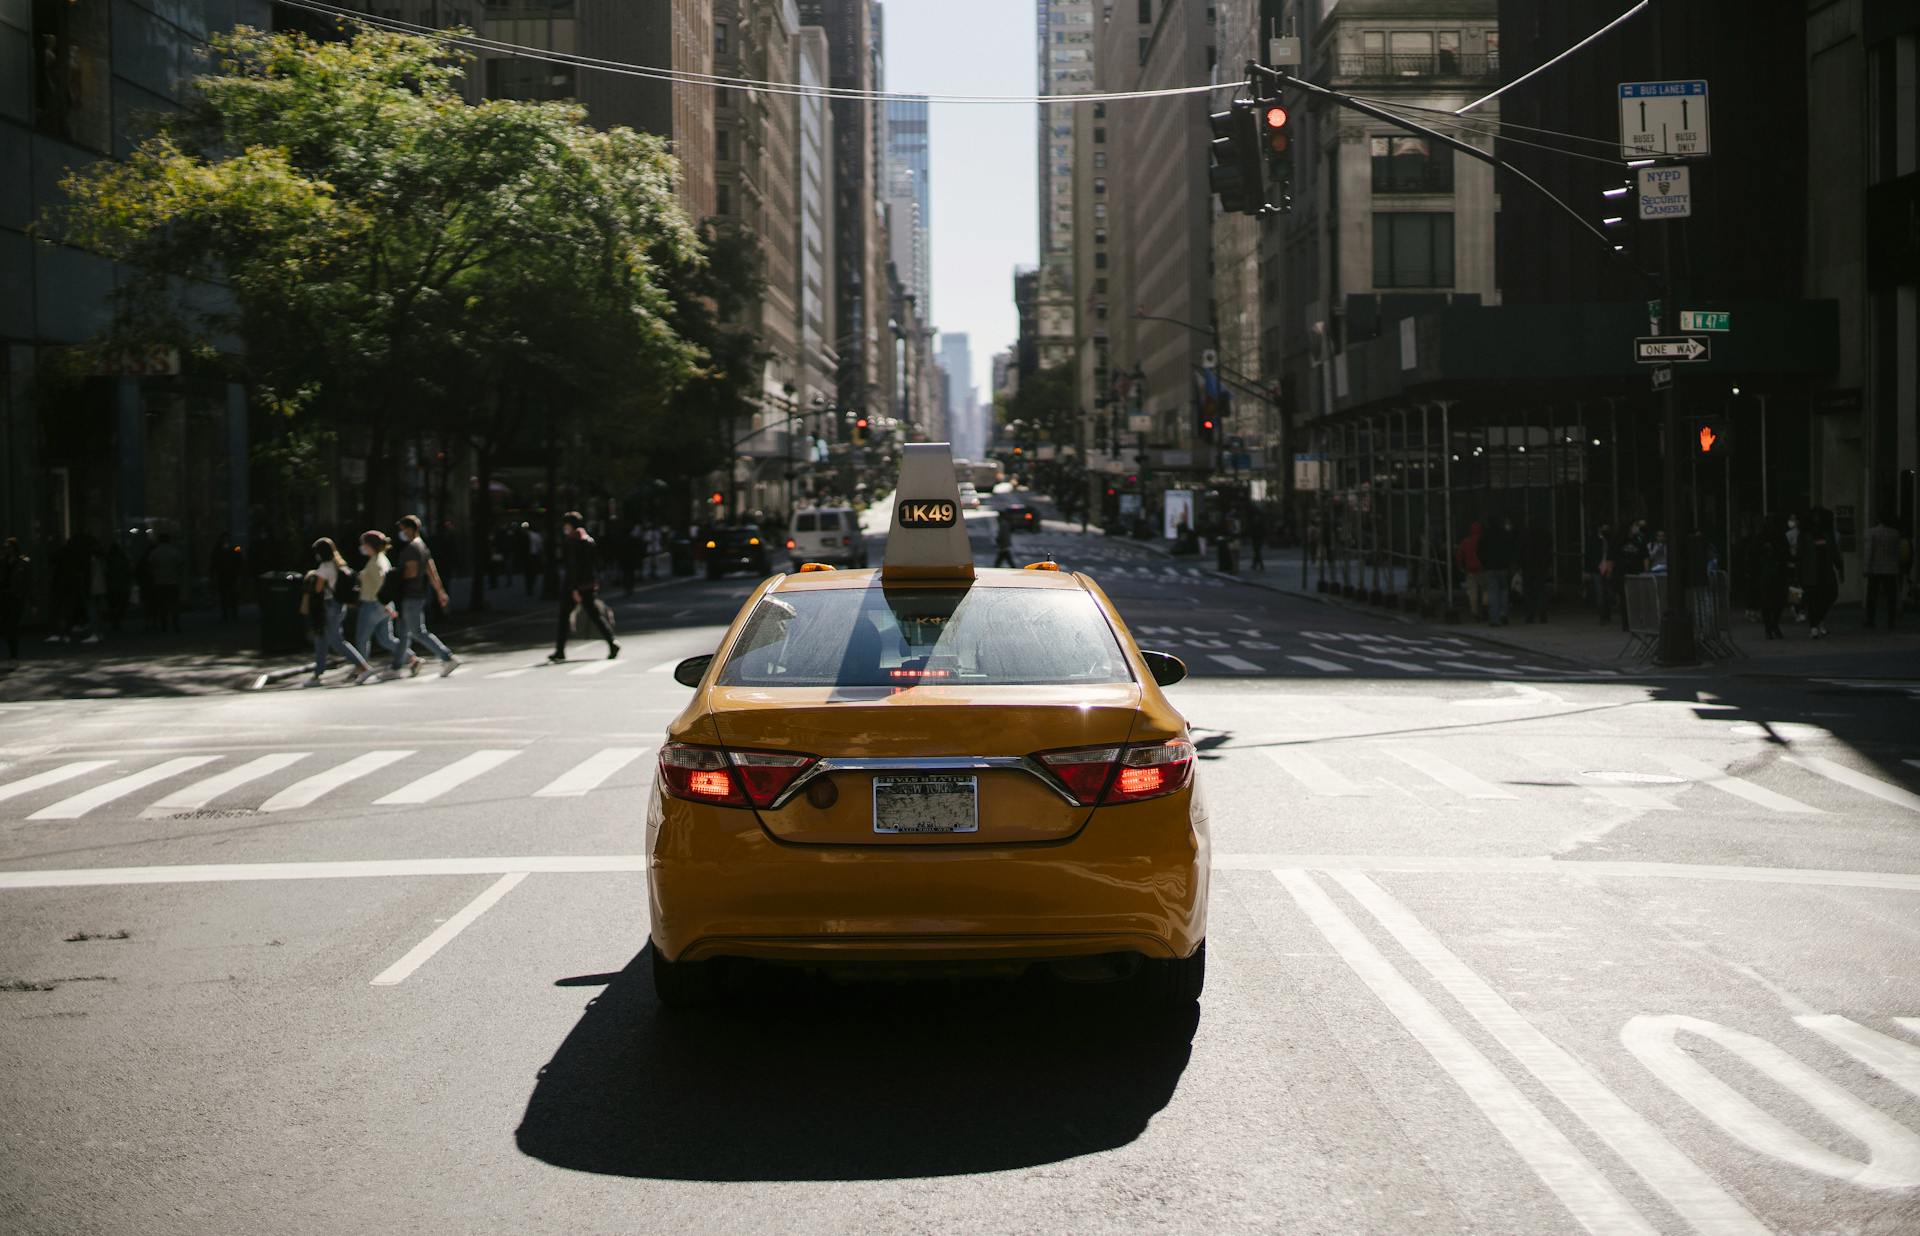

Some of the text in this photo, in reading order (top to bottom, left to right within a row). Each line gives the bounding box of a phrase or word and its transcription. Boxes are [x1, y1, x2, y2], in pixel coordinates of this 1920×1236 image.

[1640, 84, 1686, 95] BUS LANES
[1633, 134, 1655, 144] BUSES
[1675, 132, 1697, 142] BUSES
[1635, 145, 1654, 154] ONLY
[1677, 143, 1696, 152] ONLY
[1647, 170, 1681, 182] NYPD
[1696, 314, 1703, 329] W
[1706, 314, 1718, 329] 47
[1719, 315, 1728, 323] ST
[1646, 344, 1699, 355] ONE WAY
[902, 503, 954, 522] 1K49
